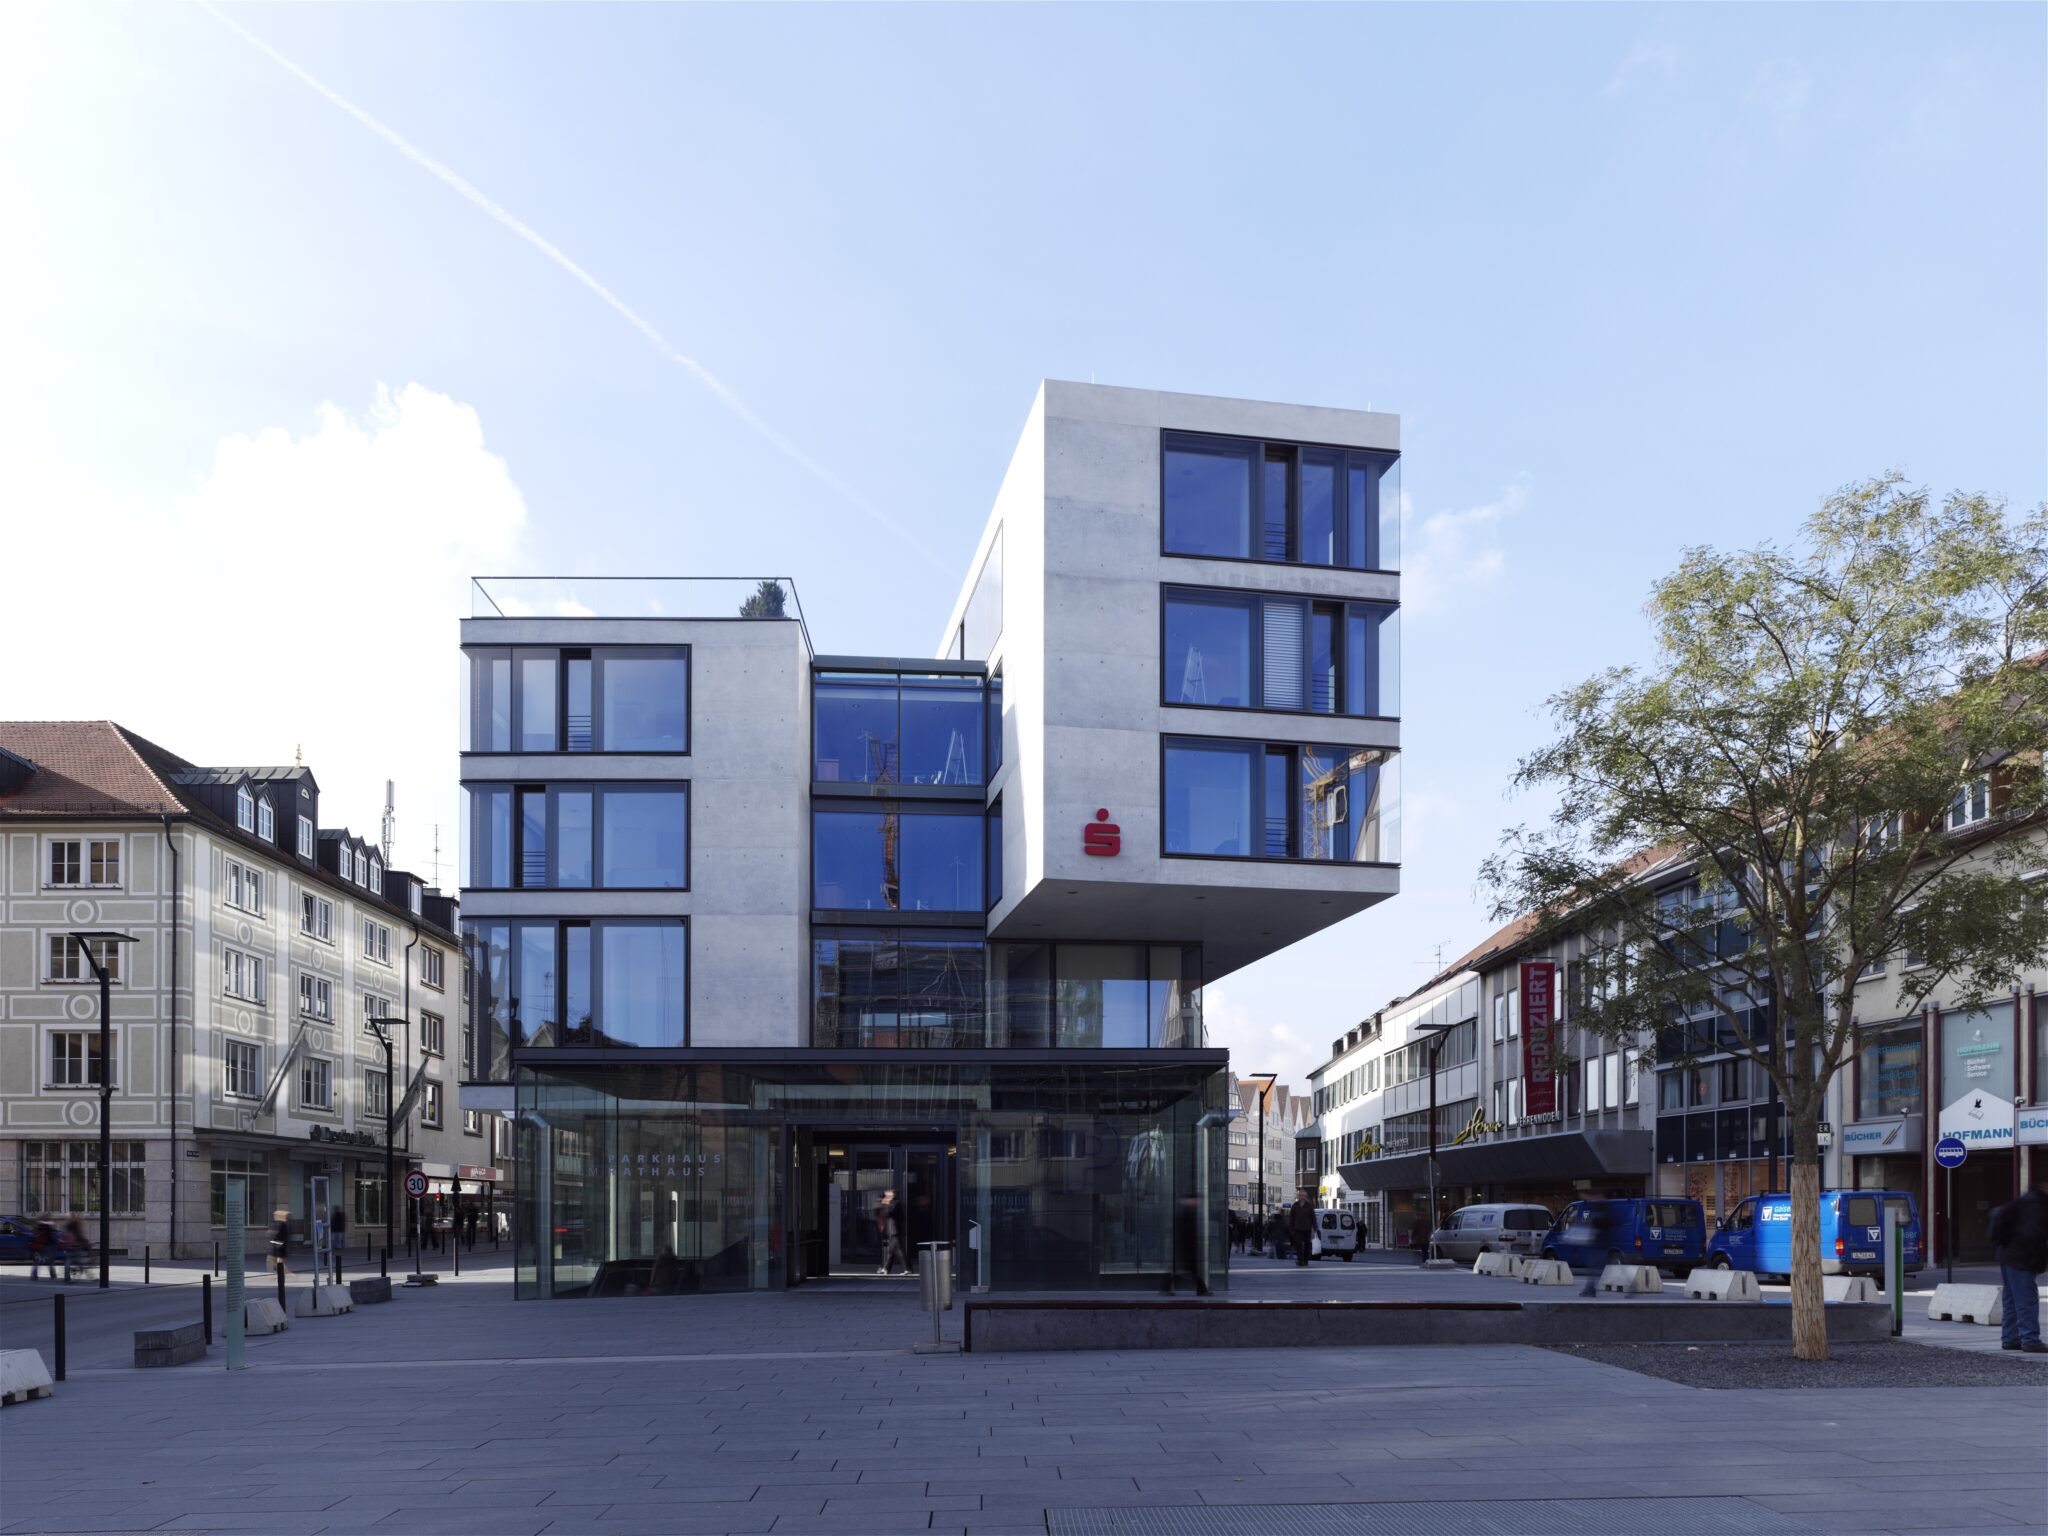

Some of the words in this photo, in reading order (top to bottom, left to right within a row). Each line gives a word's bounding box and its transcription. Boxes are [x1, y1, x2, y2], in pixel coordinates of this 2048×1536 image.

[1528, 967, 1550, 1083] REDUZIERT
[1957, 1042, 2000, 1055] HOFMANN
[1845, 1131, 1882, 1142] BÜCHER
[1943, 1128, 2013, 1140] HOFMANN
[607, 1154, 721, 1164] PARKHAUS
[608, 1167, 706, 1177] RATHAUS
[408, 1178, 424, 1191] 30
